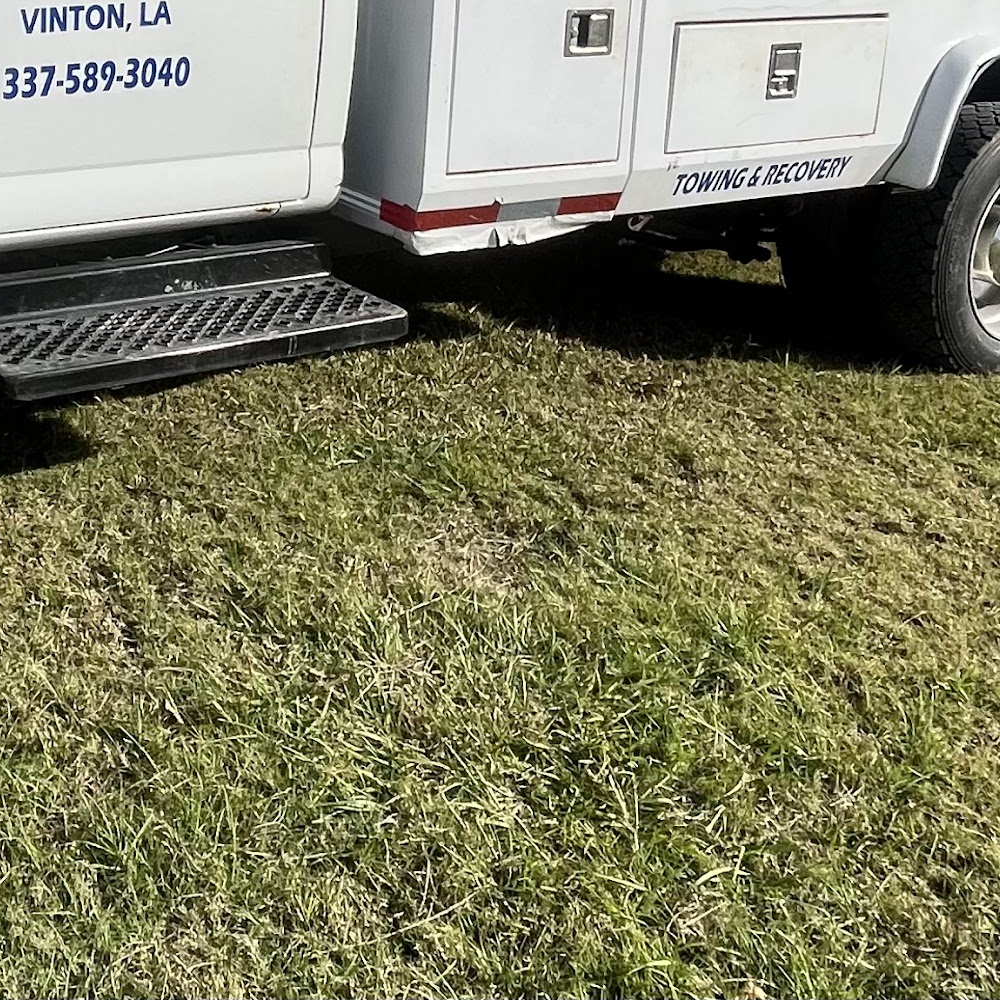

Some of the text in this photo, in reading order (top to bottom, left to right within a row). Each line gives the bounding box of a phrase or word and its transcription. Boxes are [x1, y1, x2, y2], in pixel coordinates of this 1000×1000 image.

[21, 1, 171, 34] VINTON, LA
[2, 56, 191, 100] 337-589-3040
[672, 155, 853, 196] TOWING & RECOVERY
